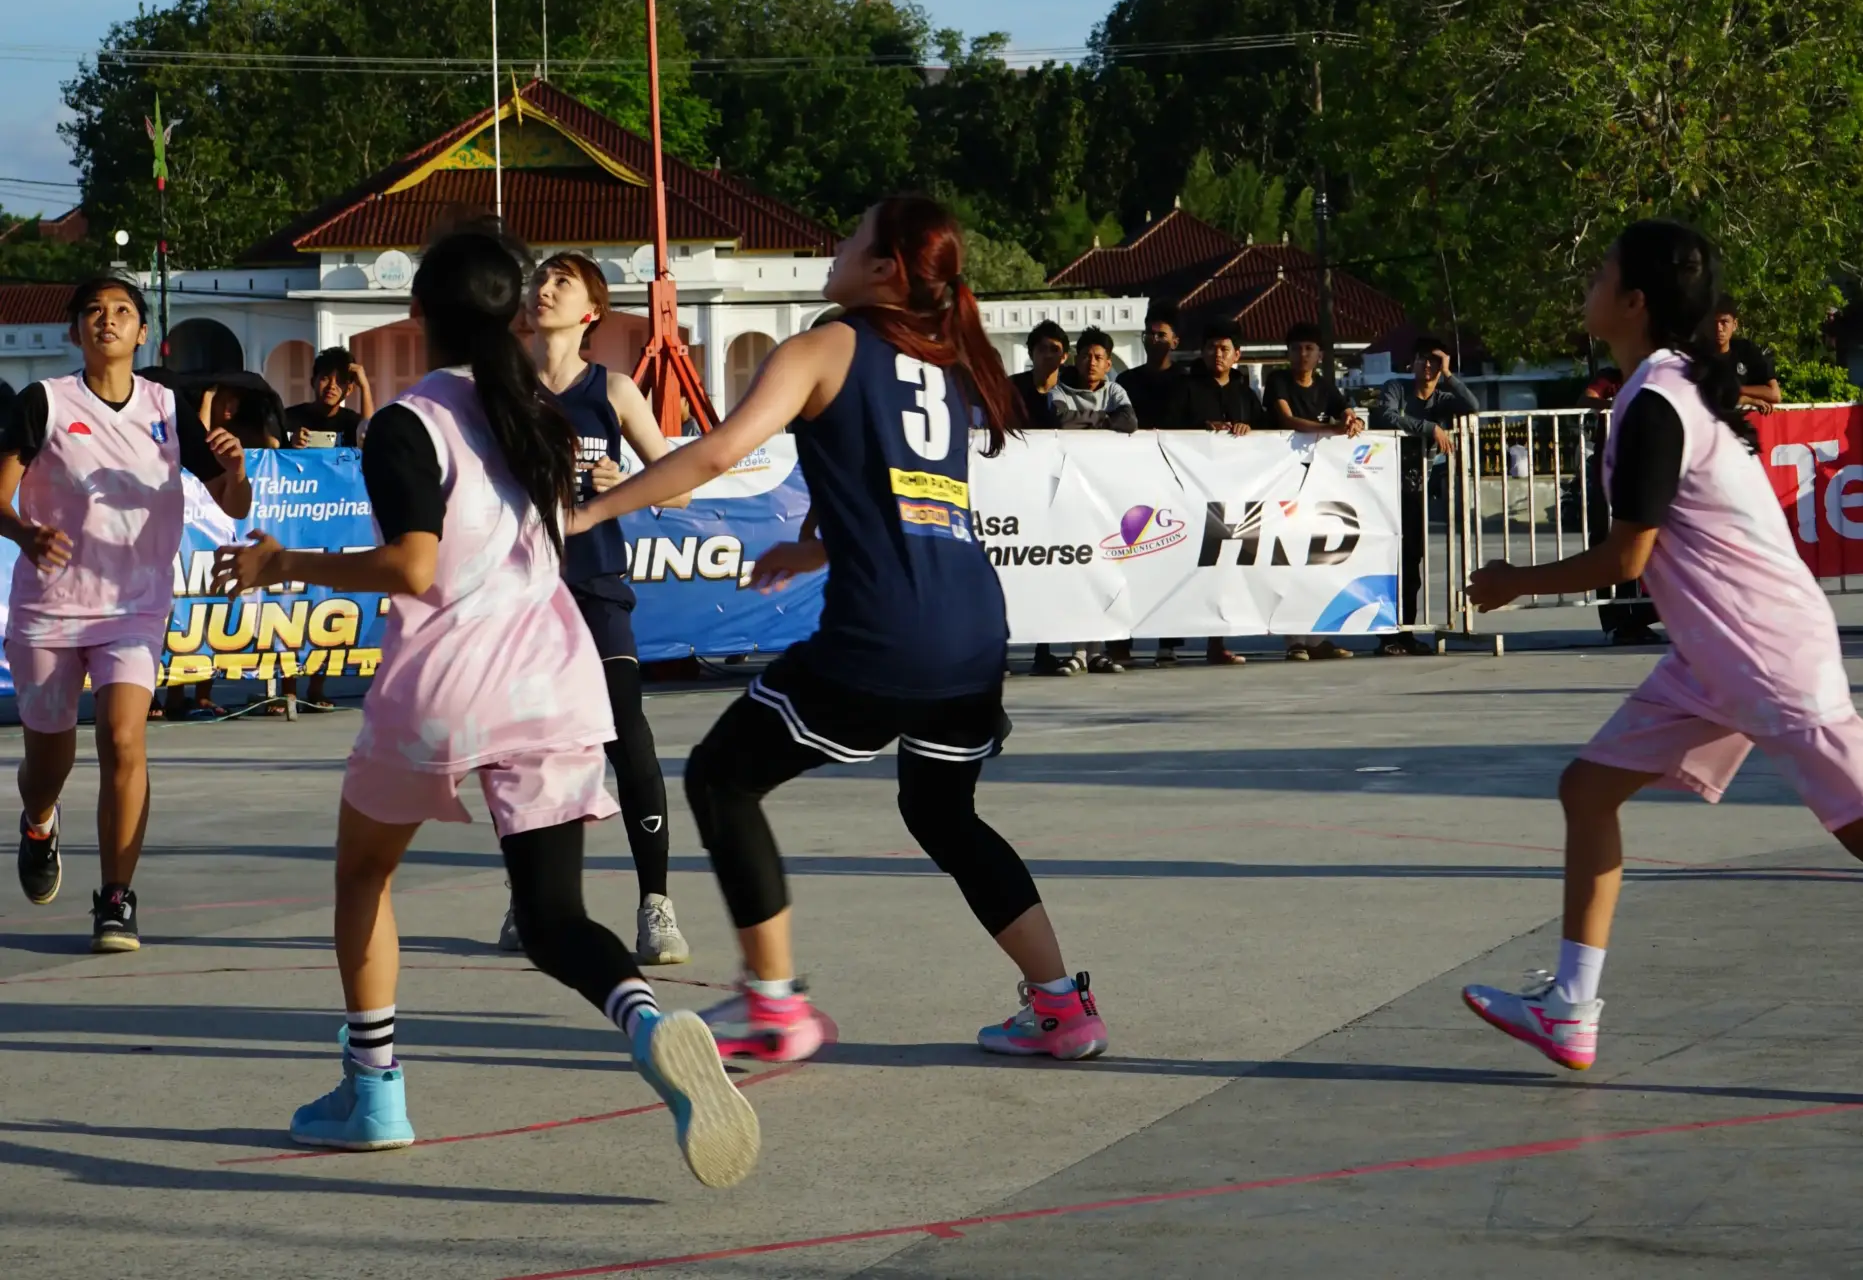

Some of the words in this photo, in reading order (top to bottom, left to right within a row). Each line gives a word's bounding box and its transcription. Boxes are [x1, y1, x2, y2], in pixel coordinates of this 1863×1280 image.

[895, 353, 951, 461] 3
[257, 476, 318, 495] Tahun
[250, 497, 372, 523] Tanjungpina
[972, 510, 1019, 536] Asa
[982, 540, 1093, 566] niverse
[1105, 532, 1182, 557] COMMUNICATION
[163, 598, 360, 653] JUNG
